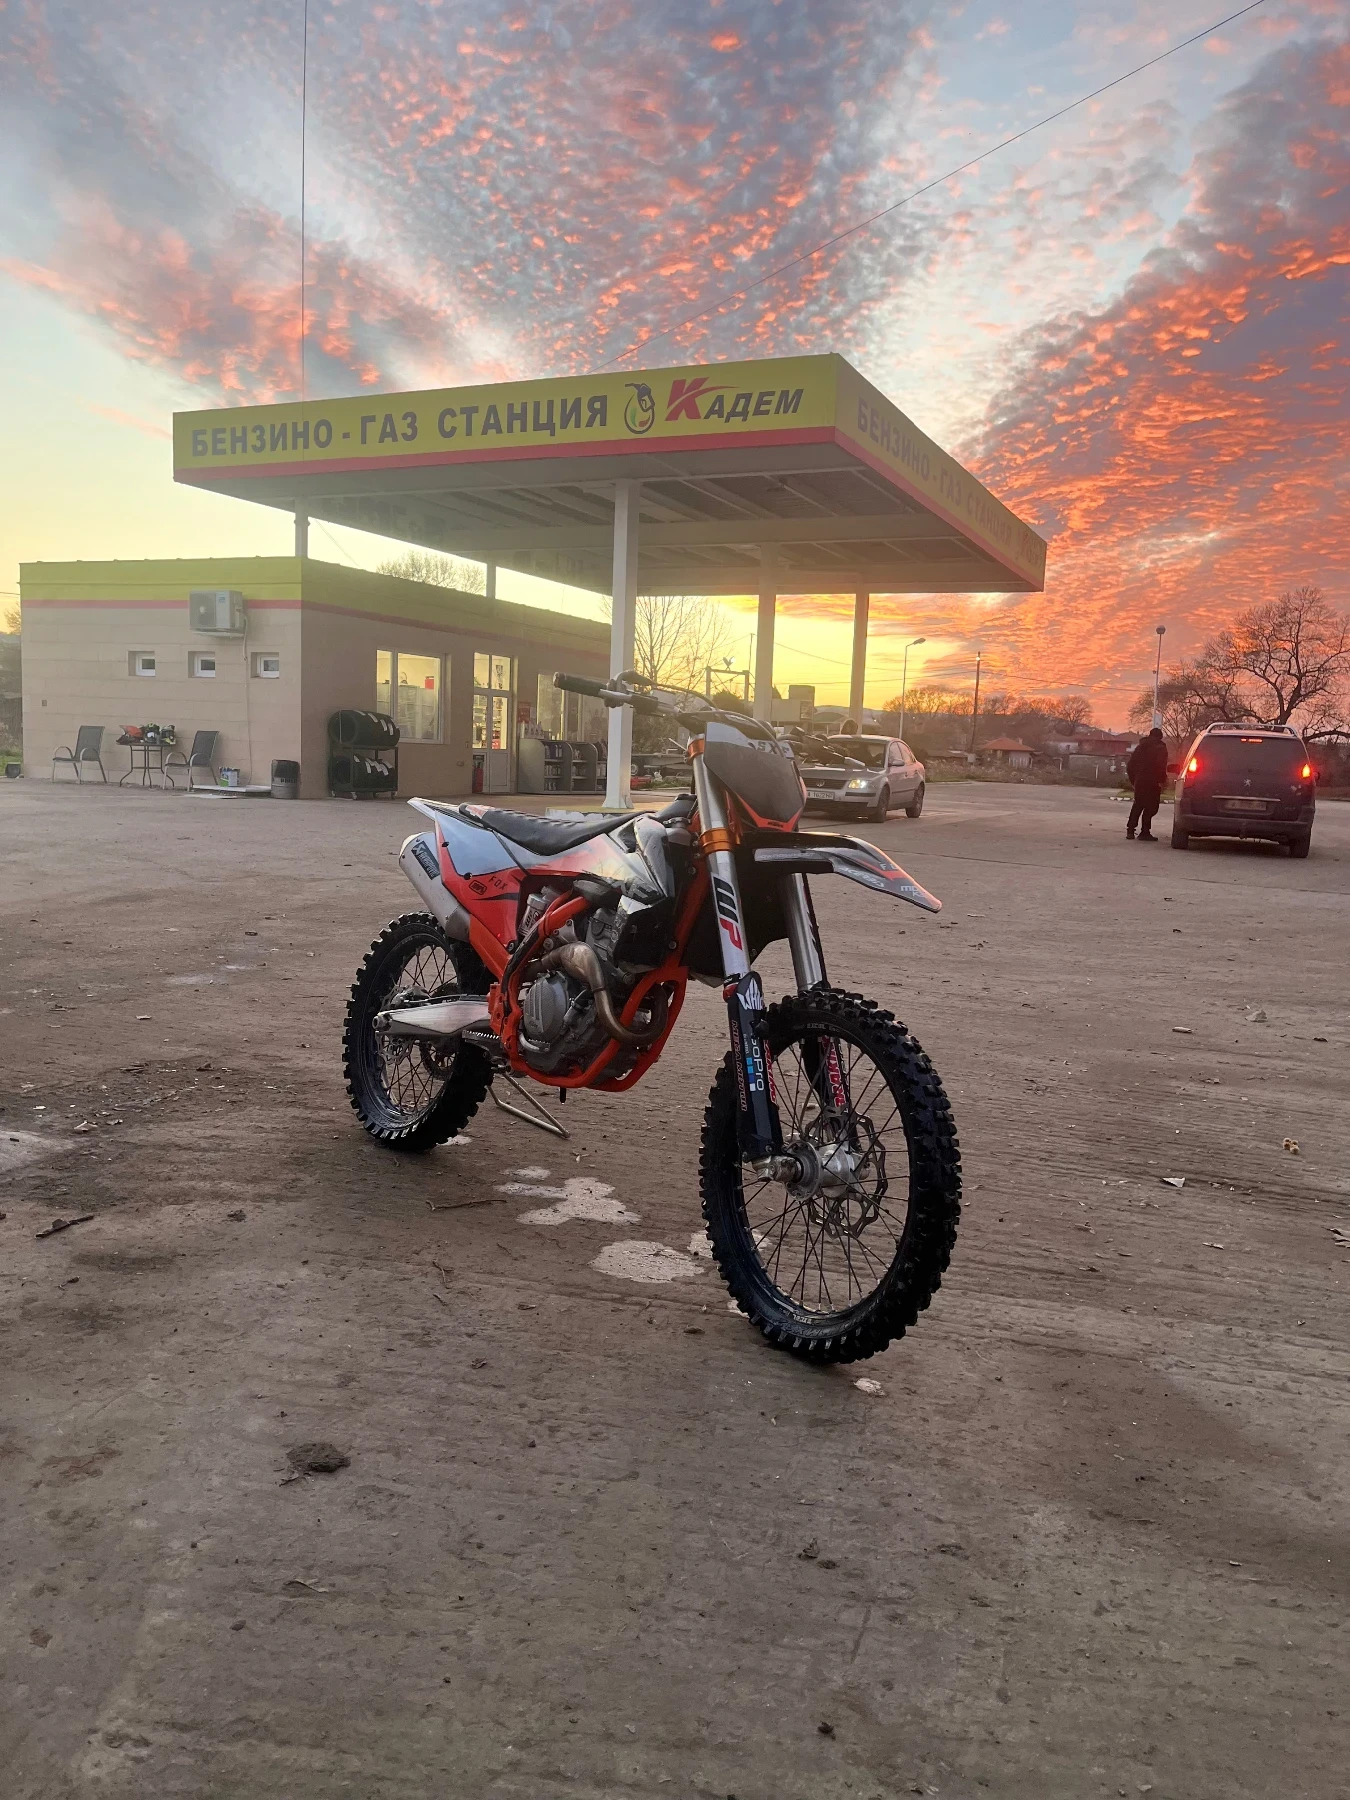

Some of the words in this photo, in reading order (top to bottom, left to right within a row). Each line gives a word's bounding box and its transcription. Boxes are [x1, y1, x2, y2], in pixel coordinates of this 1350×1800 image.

[191, 418, 333, 457] БЕНЗИНО
[360, 411, 418, 445] ГАЗ
[437, 394, 608, 437] СТАНЦИЯ
[857, 396, 930, 482] БЕНЗИНО
[940, 467, 962, 507] ГАЗ
[488, 875, 508, 891] FOX
